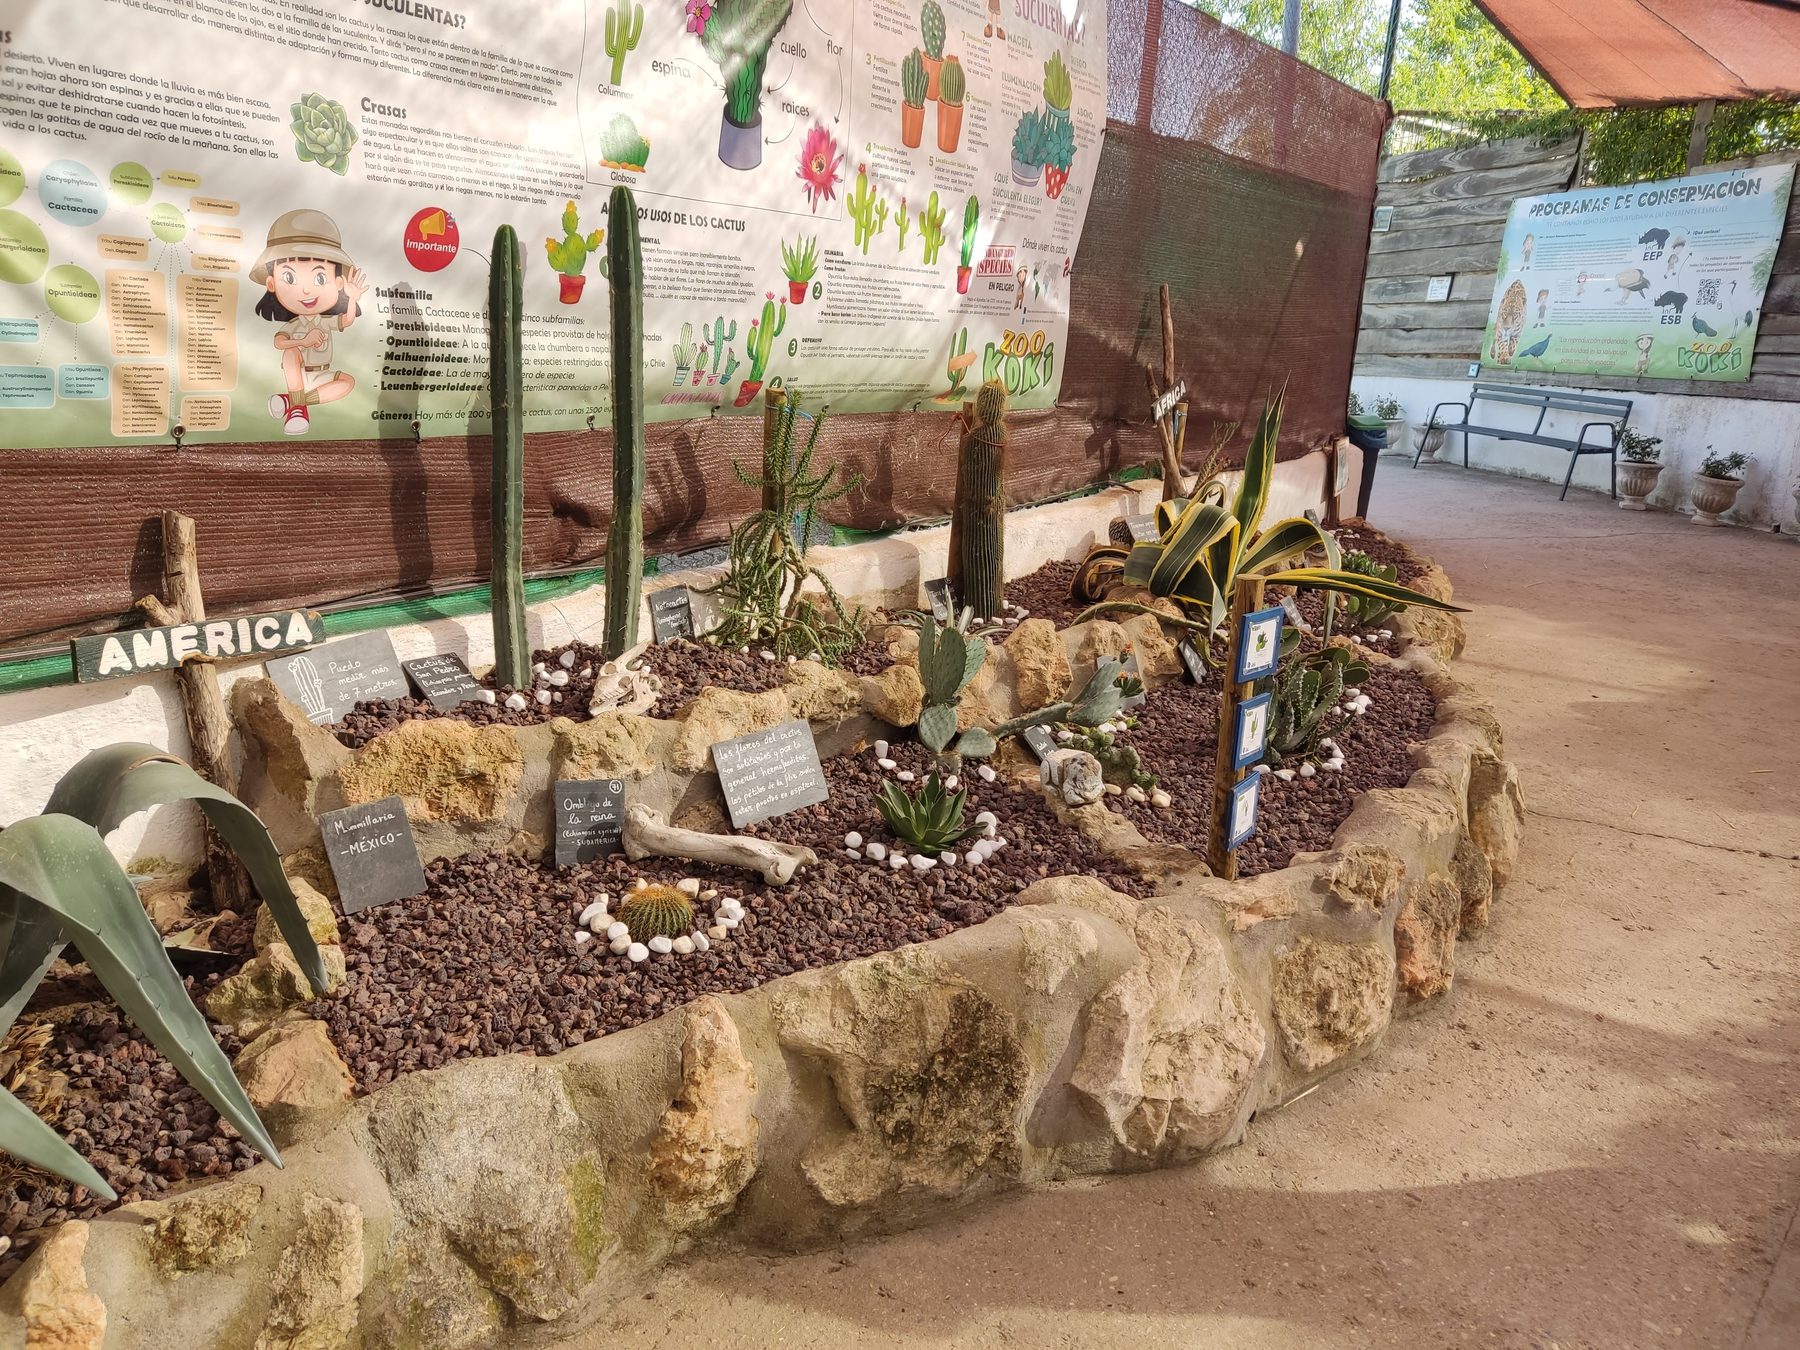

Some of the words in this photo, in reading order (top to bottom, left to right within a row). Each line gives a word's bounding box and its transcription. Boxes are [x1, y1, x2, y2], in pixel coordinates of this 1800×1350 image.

[292, 4, 323, 16] realidad
[324, 12, 336, 20] son
[338, 13, 347, 22] los
[348, 18, 369, 28] cactus
[376, 24, 384, 32] las
[386, 28, 406, 37] crasas
[407, 32, 416, 40] los
[431, 39, 448, 48] están
[450, 42, 470, 53] dentro
[480, 49, 486, 57] la
[487, 51, 508, 62] familia
[517, 58, 522, 66] lo
[541, 66, 559, 75] conoce
[780, 42, 807, 59] cuello
[827, 40, 843, 56] flor
[651, 59, 691, 78] espina
[3, 50, 44, 64] desierto.
[48, 57, 75, 69] Viven
[78, 64, 90, 72] en
[93, 66, 126, 79] lugares
[129, 74, 158, 86] donde
[160, 79, 169, 88] la
[171, 81, 195, 93] lluvia
[208, 90, 224, 99] más
[226, 92, 243, 103] bien
[245, 98, 271, 108] escasa.
[598, 83, 634, 99] Columnar
[361, 96, 407, 119] Crasas
[782, 101, 810, 117] raices
[610, 171, 637, 184] Globosa
[992, 187, 1022, 202] SUCULENTA
[48, 201, 98, 215] Cactaceae
[1529, 196, 1610, 218] PROGRAMAS
[1614, 193, 1635, 210] DE
[650, 209, 671, 223] USOS
[674, 212, 687, 225] DE
[689, 214, 708, 227] LOS
[710, 217, 745, 231] CACTUS
[406, 239, 457, 253] Importante
[1642, 251, 1663, 262] EEP
[979, 257, 1012, 274] SPECIES
[48, 288, 98, 300] Opuntioideae
[375, 287, 432, 300] Subfamilia
[988, 282, 995, 291] EN
[996, 282, 1014, 292] PELIGRO
[377, 303, 389, 313] La
[391, 304, 422, 316] familia
[425, 306, 469, 318] Cactaceae
[542, 314, 584, 324] subfamilias:
[1660, 315, 1681, 325] ESB
[553, 330, 584, 338] provistas
[386, 336, 460, 348] Opuntioideae:
[462, 339, 469, 348] A
[470, 340, 481, 348] la
[1000, 329, 1045, 357] ZOO
[1691, 341, 1732, 354] ZOO
[384, 352, 470, 363] Maihuenioideae:
[650, 358, 665, 367] Chile
[382, 366, 443, 376] Cactoideae:
[446, 368, 458, 377] La
[460, 369, 471, 377] de
[381, 381, 485, 392] Leuenbergerioideae:
[1156, 380, 1186, 421] AFRICA
[371, 410, 412, 420] Géneros
[414, 410, 433, 422] Hay
[436, 410, 452, 418] más
[455, 410, 465, 418] de
[468, 410, 484, 418] 200
[99, 612, 313, 675] AMERICA
[329, 660, 361, 674] Puedo
[409, 659, 445, 671] Cactus
[445, 656, 457, 664] de
[338, 673, 366, 686] medir
[371, 664, 389, 675] más
[415, 671, 432, 679] San
[433, 665, 460, 675] Pedro
[339, 692, 350, 701] de
[352, 687, 361, 698] 7
[736, 741, 761, 761] flores
[764, 732, 777, 744] del
[727, 771, 757, 792] general
[602, 797, 613, 807] de
[568, 813, 582, 825] la
[590, 812, 616, 822] reina
